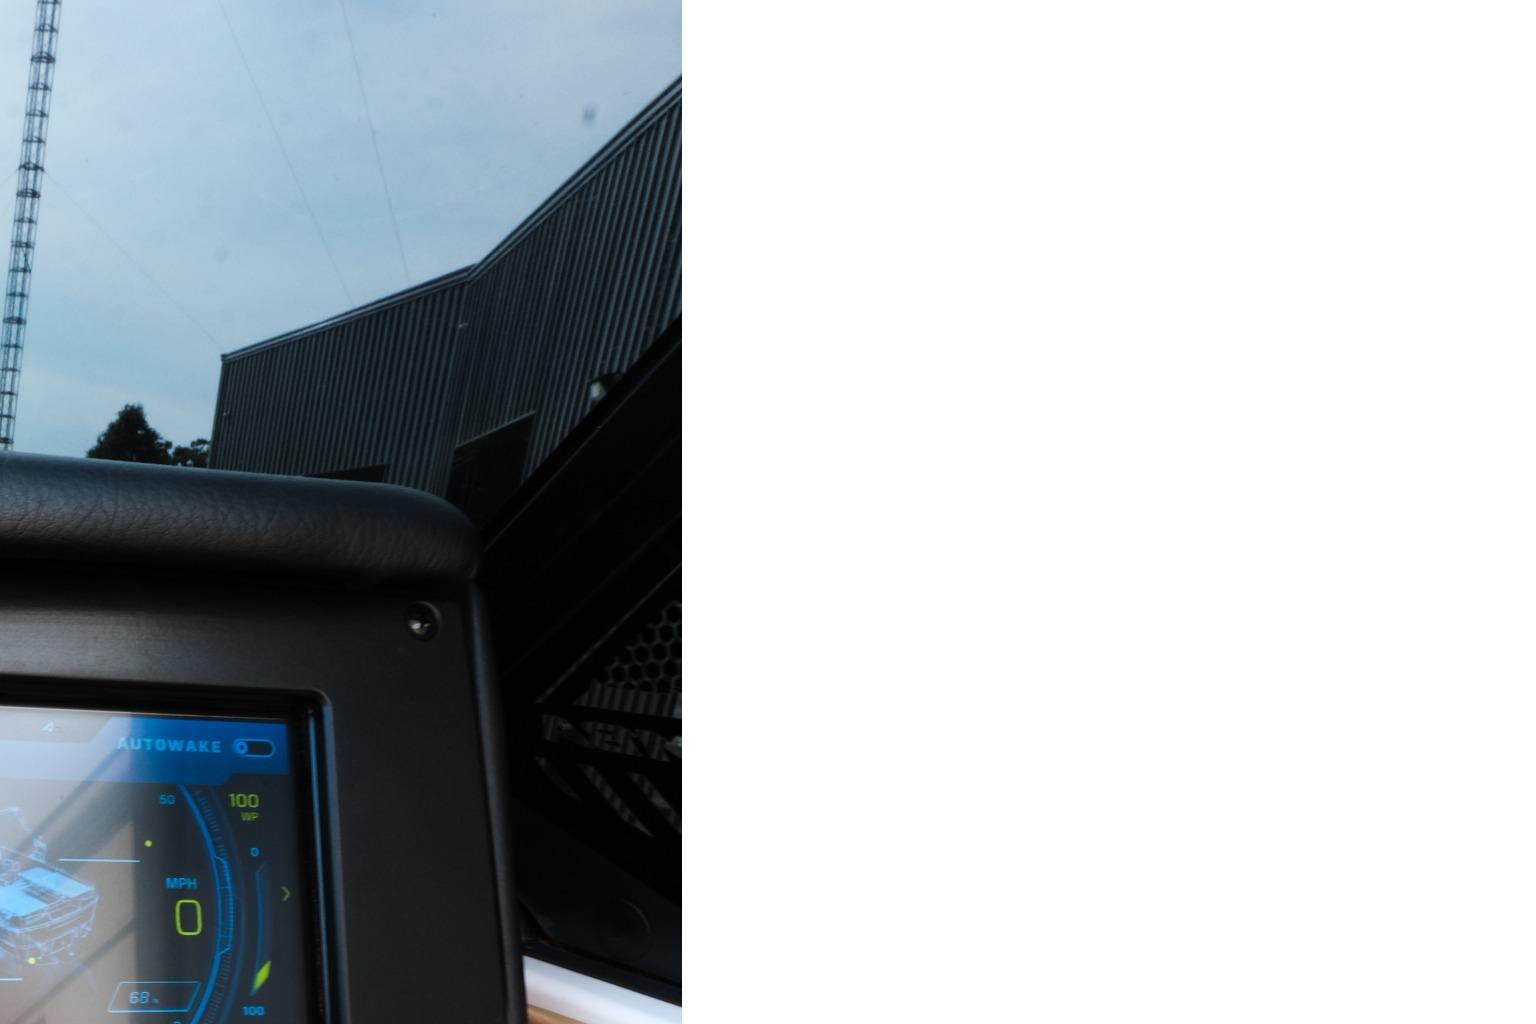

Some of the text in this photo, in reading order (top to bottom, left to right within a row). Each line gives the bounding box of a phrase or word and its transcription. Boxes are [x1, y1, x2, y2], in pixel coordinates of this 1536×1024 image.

[117, 737, 222, 753] AUTOWAKE
[229, 793, 259, 808] 100
[166, 877, 198, 889] MPH
[175, 899, 203, 936] 0
